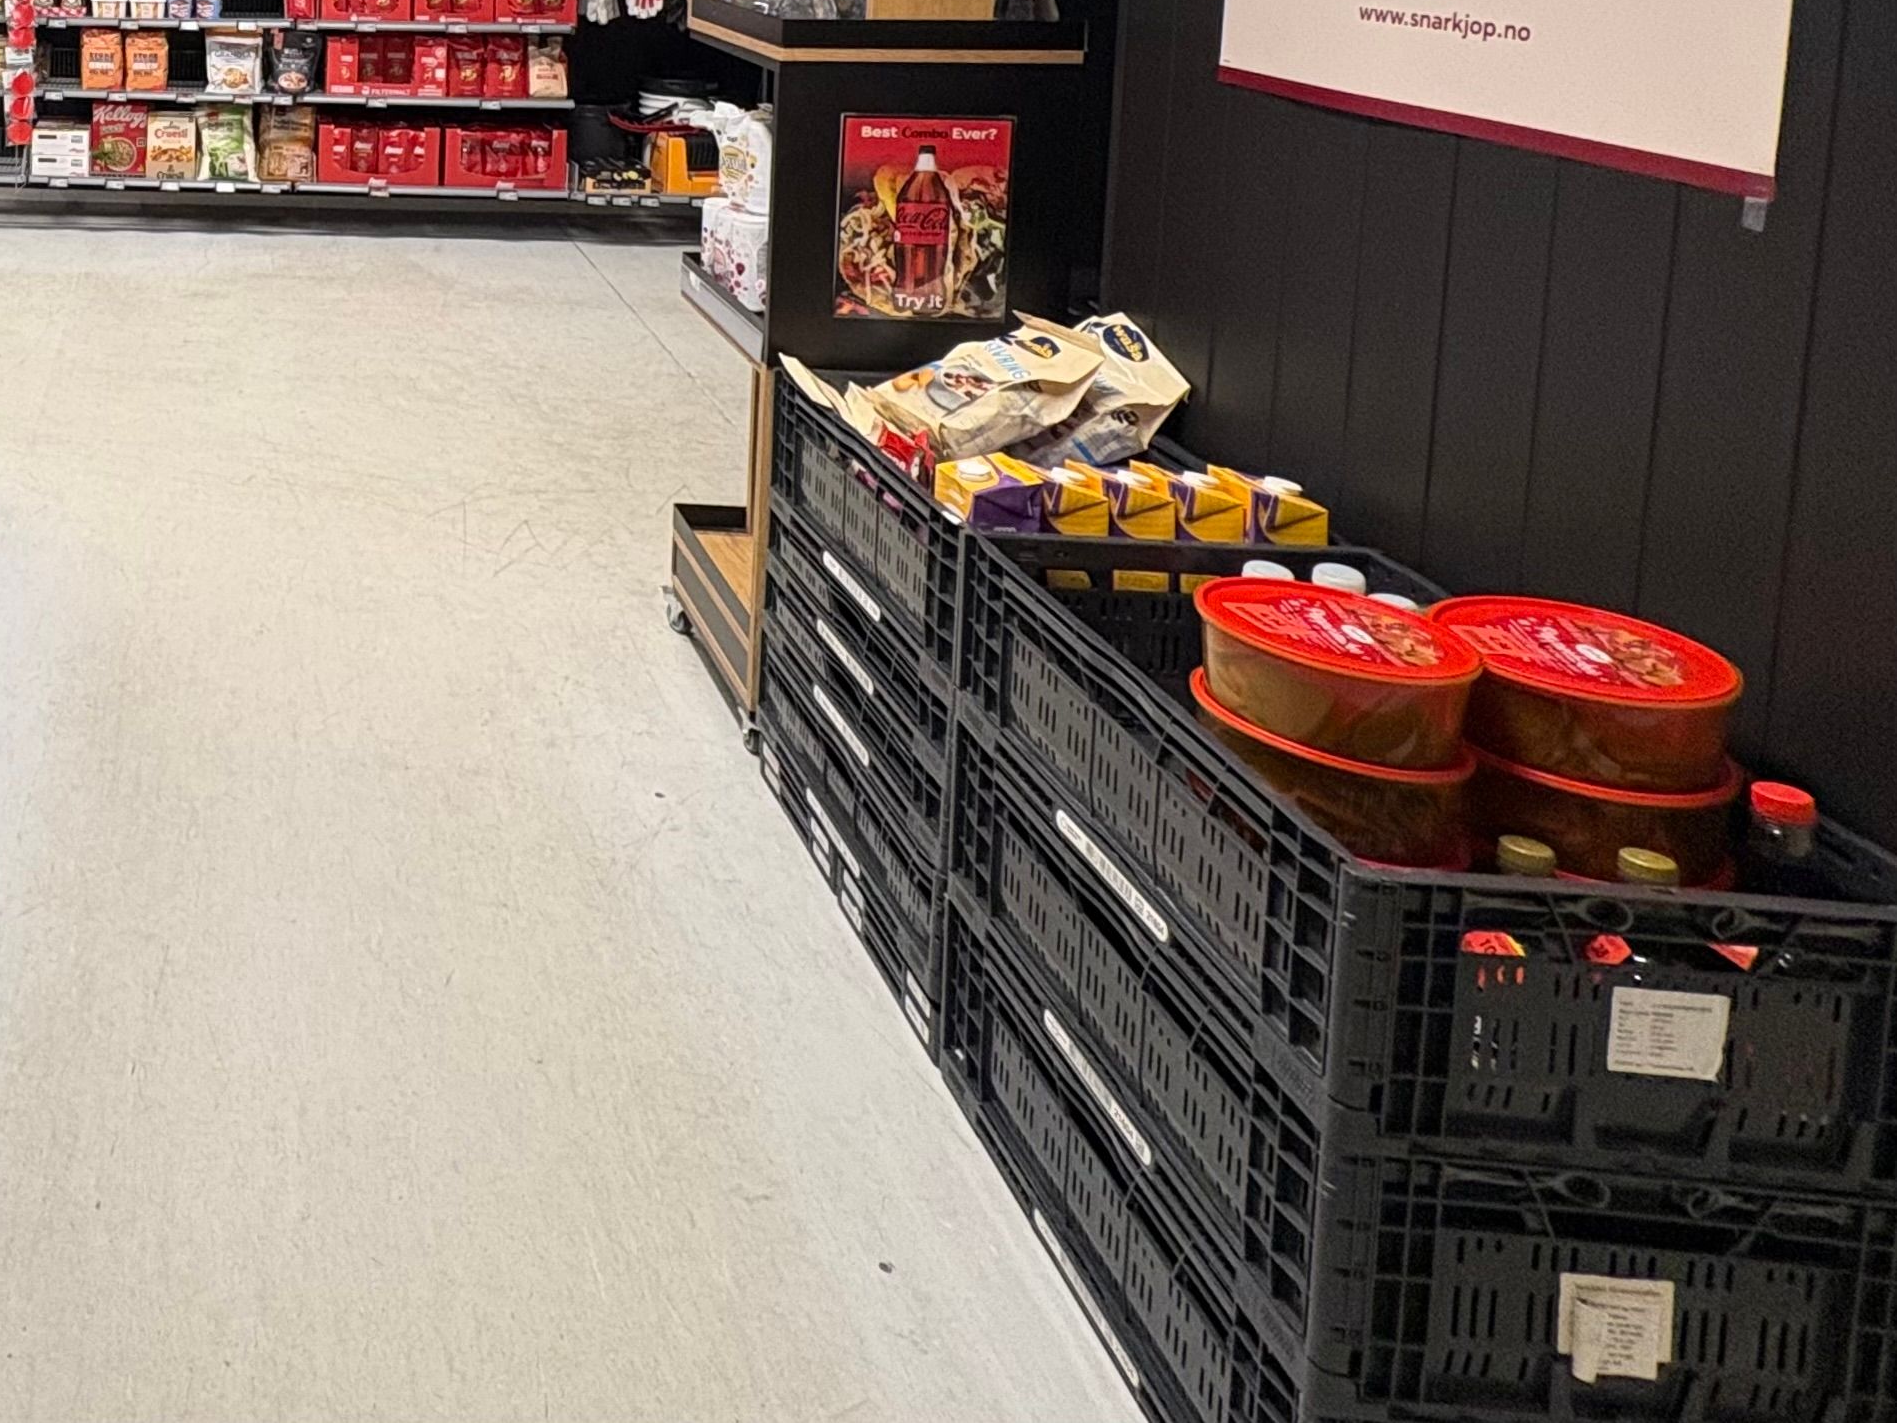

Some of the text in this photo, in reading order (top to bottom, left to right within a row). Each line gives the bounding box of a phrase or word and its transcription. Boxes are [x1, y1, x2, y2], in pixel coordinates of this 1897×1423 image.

[1357, 4, 1532, 42] www.snarkjop.no
[860, 125, 999, 141] Best Combo Ever?
[895, 293, 925, 311] Try
